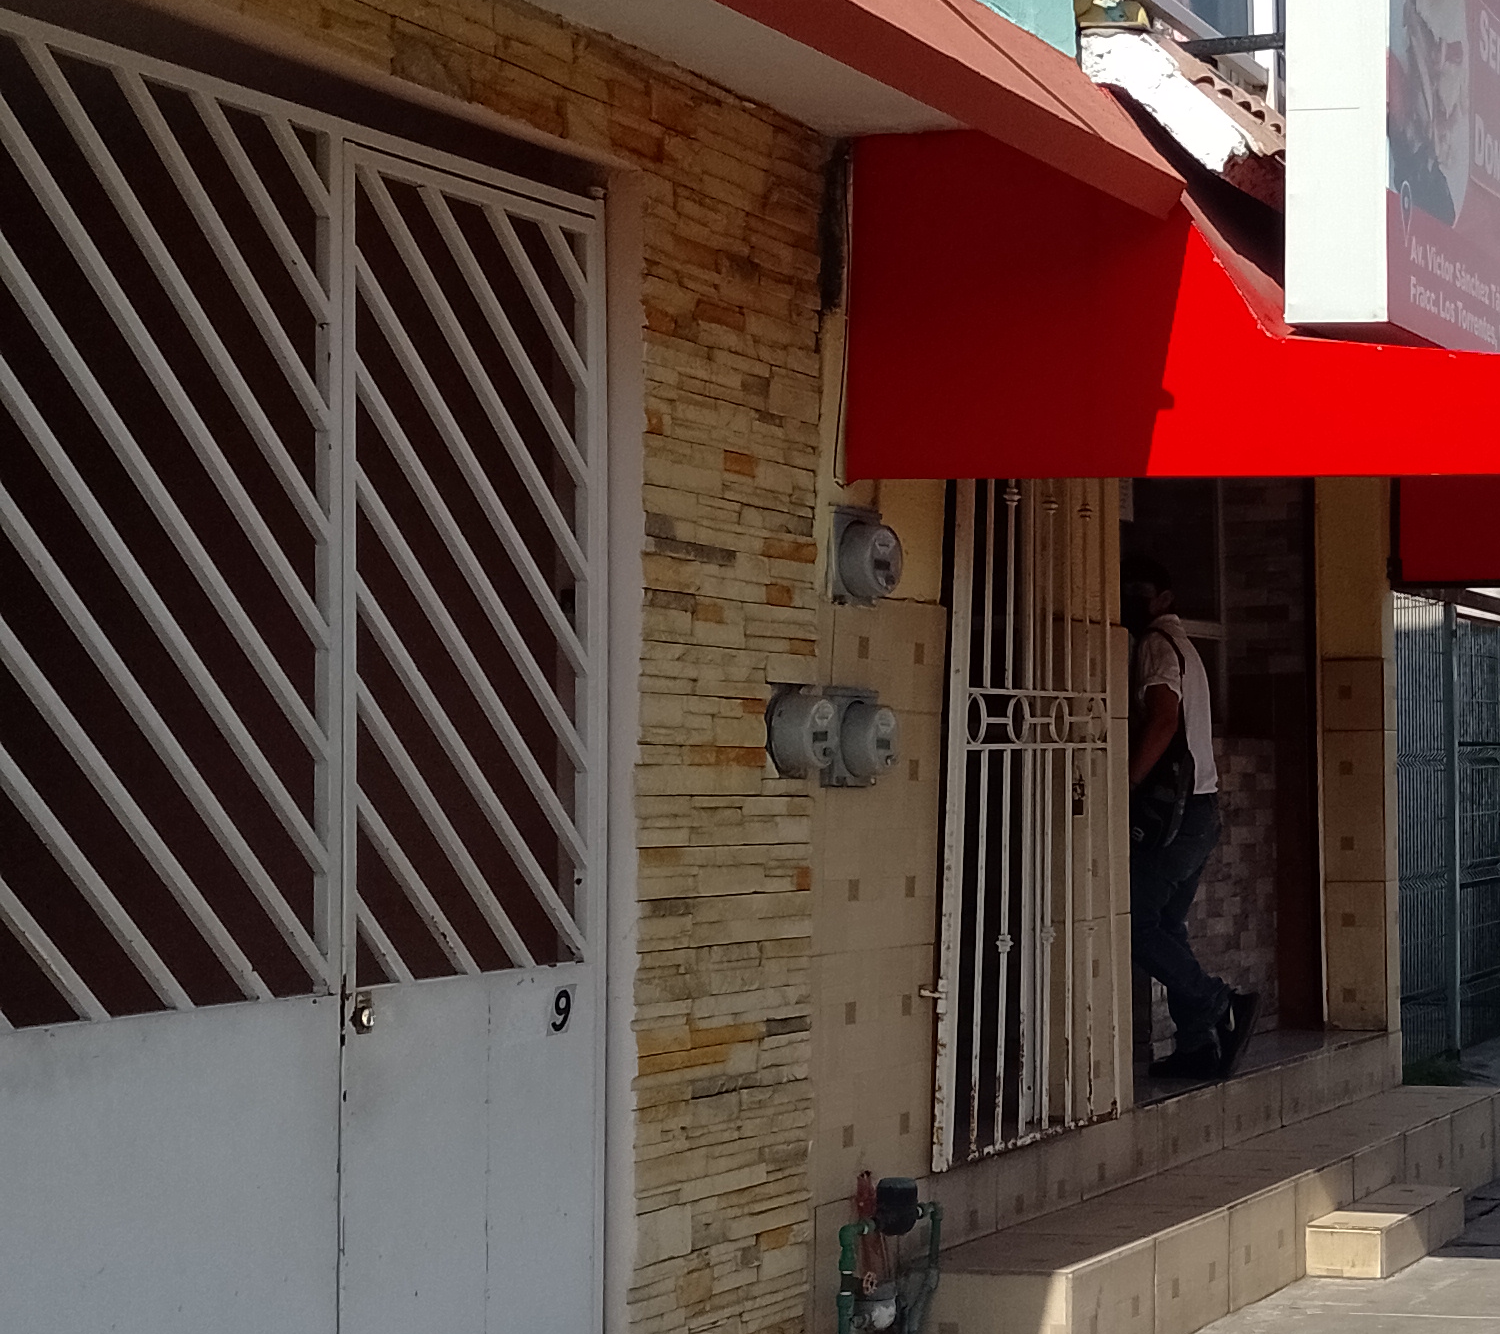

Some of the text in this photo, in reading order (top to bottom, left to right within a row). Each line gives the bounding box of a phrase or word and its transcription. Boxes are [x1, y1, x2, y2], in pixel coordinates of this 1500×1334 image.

[1410, 235, 1425, 268] Av.
[1410, 275, 1438, 315] Fracc.
[1439, 291, 1456, 324] Los
[551, 989, 571, 1032] 9
